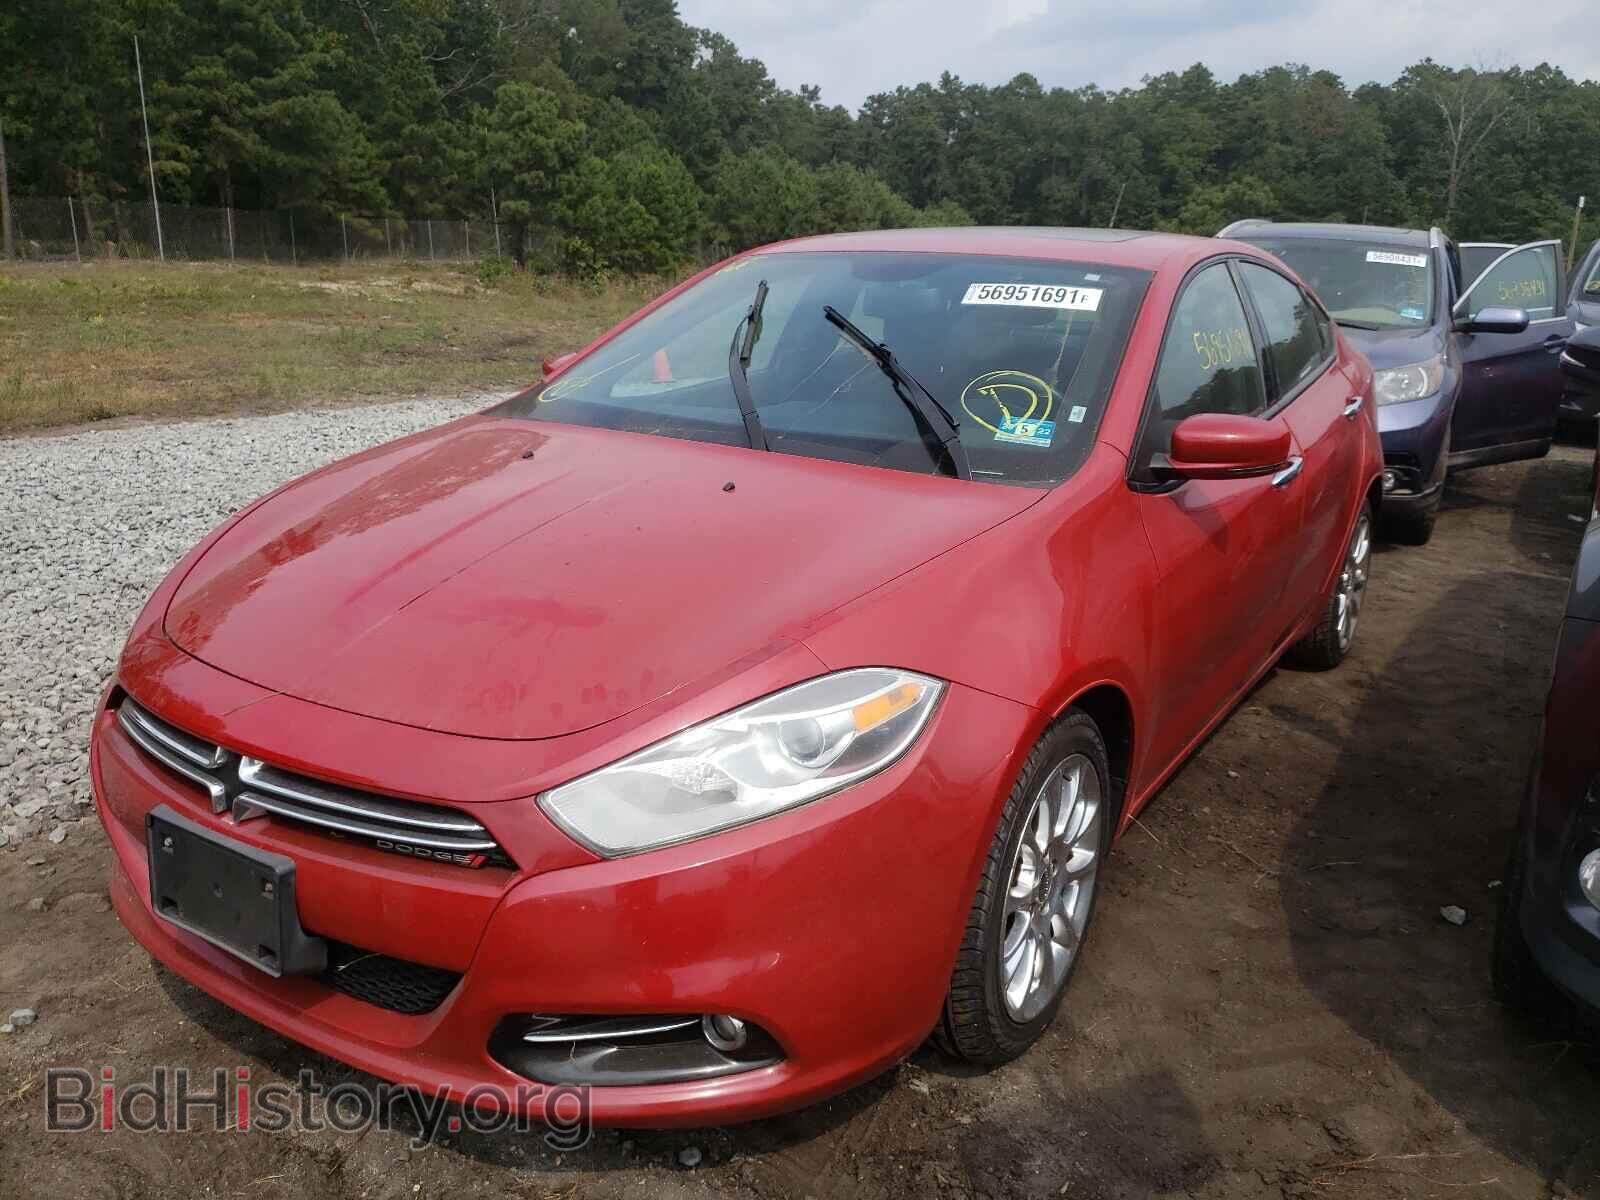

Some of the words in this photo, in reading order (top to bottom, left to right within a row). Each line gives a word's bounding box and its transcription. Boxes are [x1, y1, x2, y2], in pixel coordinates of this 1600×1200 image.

[978, 285, 1079, 304] 56951691
[1037, 427, 1051, 435] 22
[376, 839, 471, 865] DODGE
